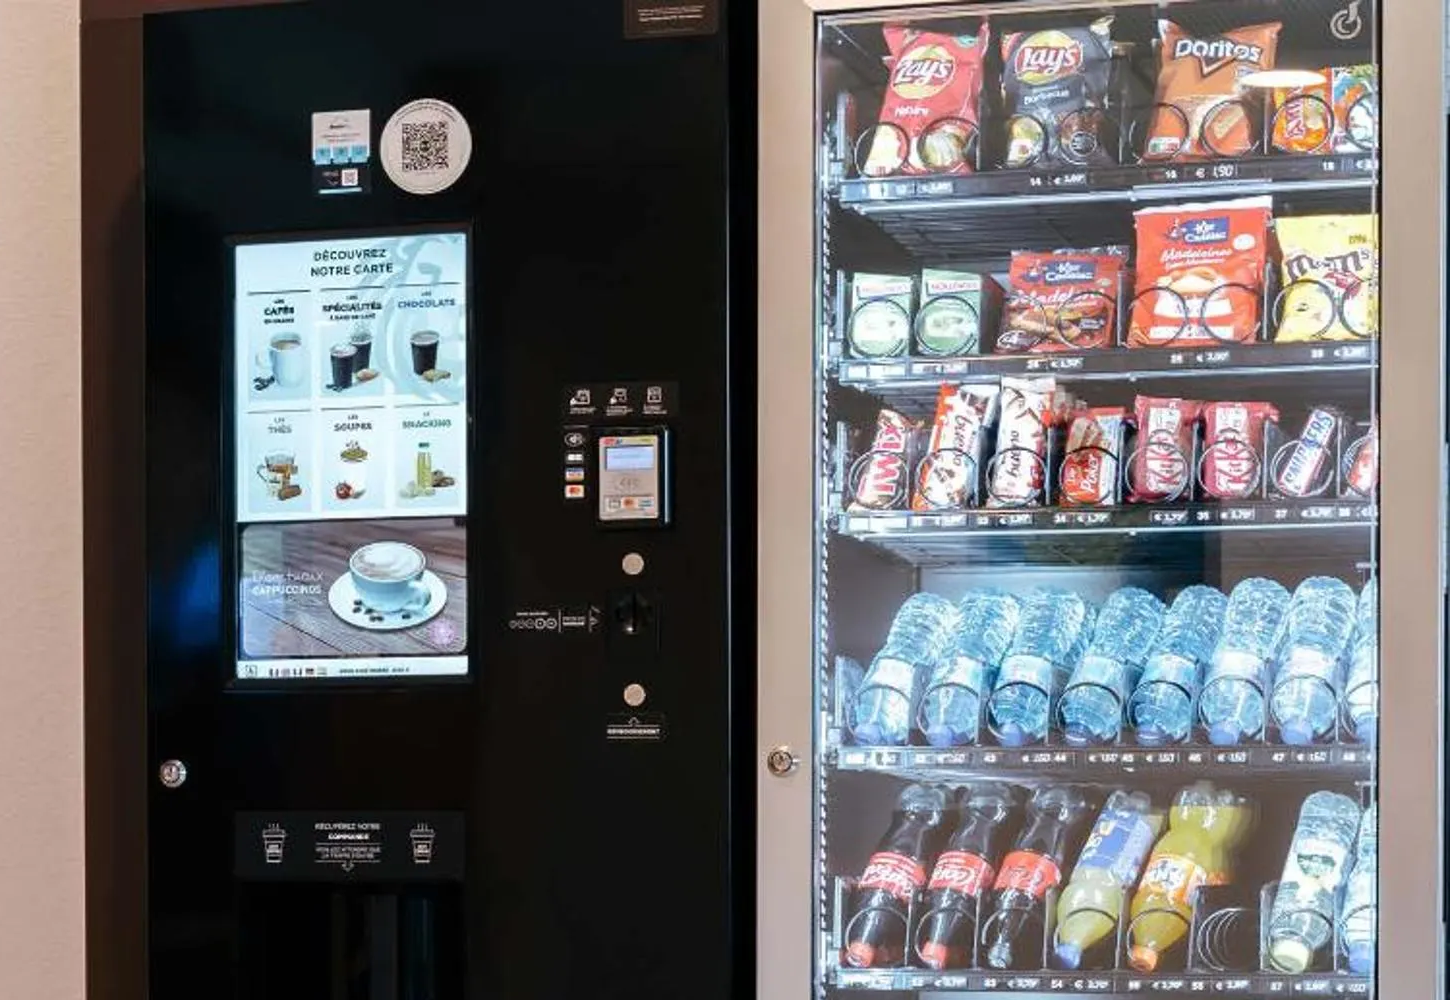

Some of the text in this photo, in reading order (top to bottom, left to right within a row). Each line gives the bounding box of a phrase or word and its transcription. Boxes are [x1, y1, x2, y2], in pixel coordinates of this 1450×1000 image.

[1175, 39, 1262, 62] Doritos
[313, 248, 387, 262] DÉCOUVREZ
[310, 262, 394, 277] NOTRE CARTE
[263, 305, 295, 316] CAFÉS
